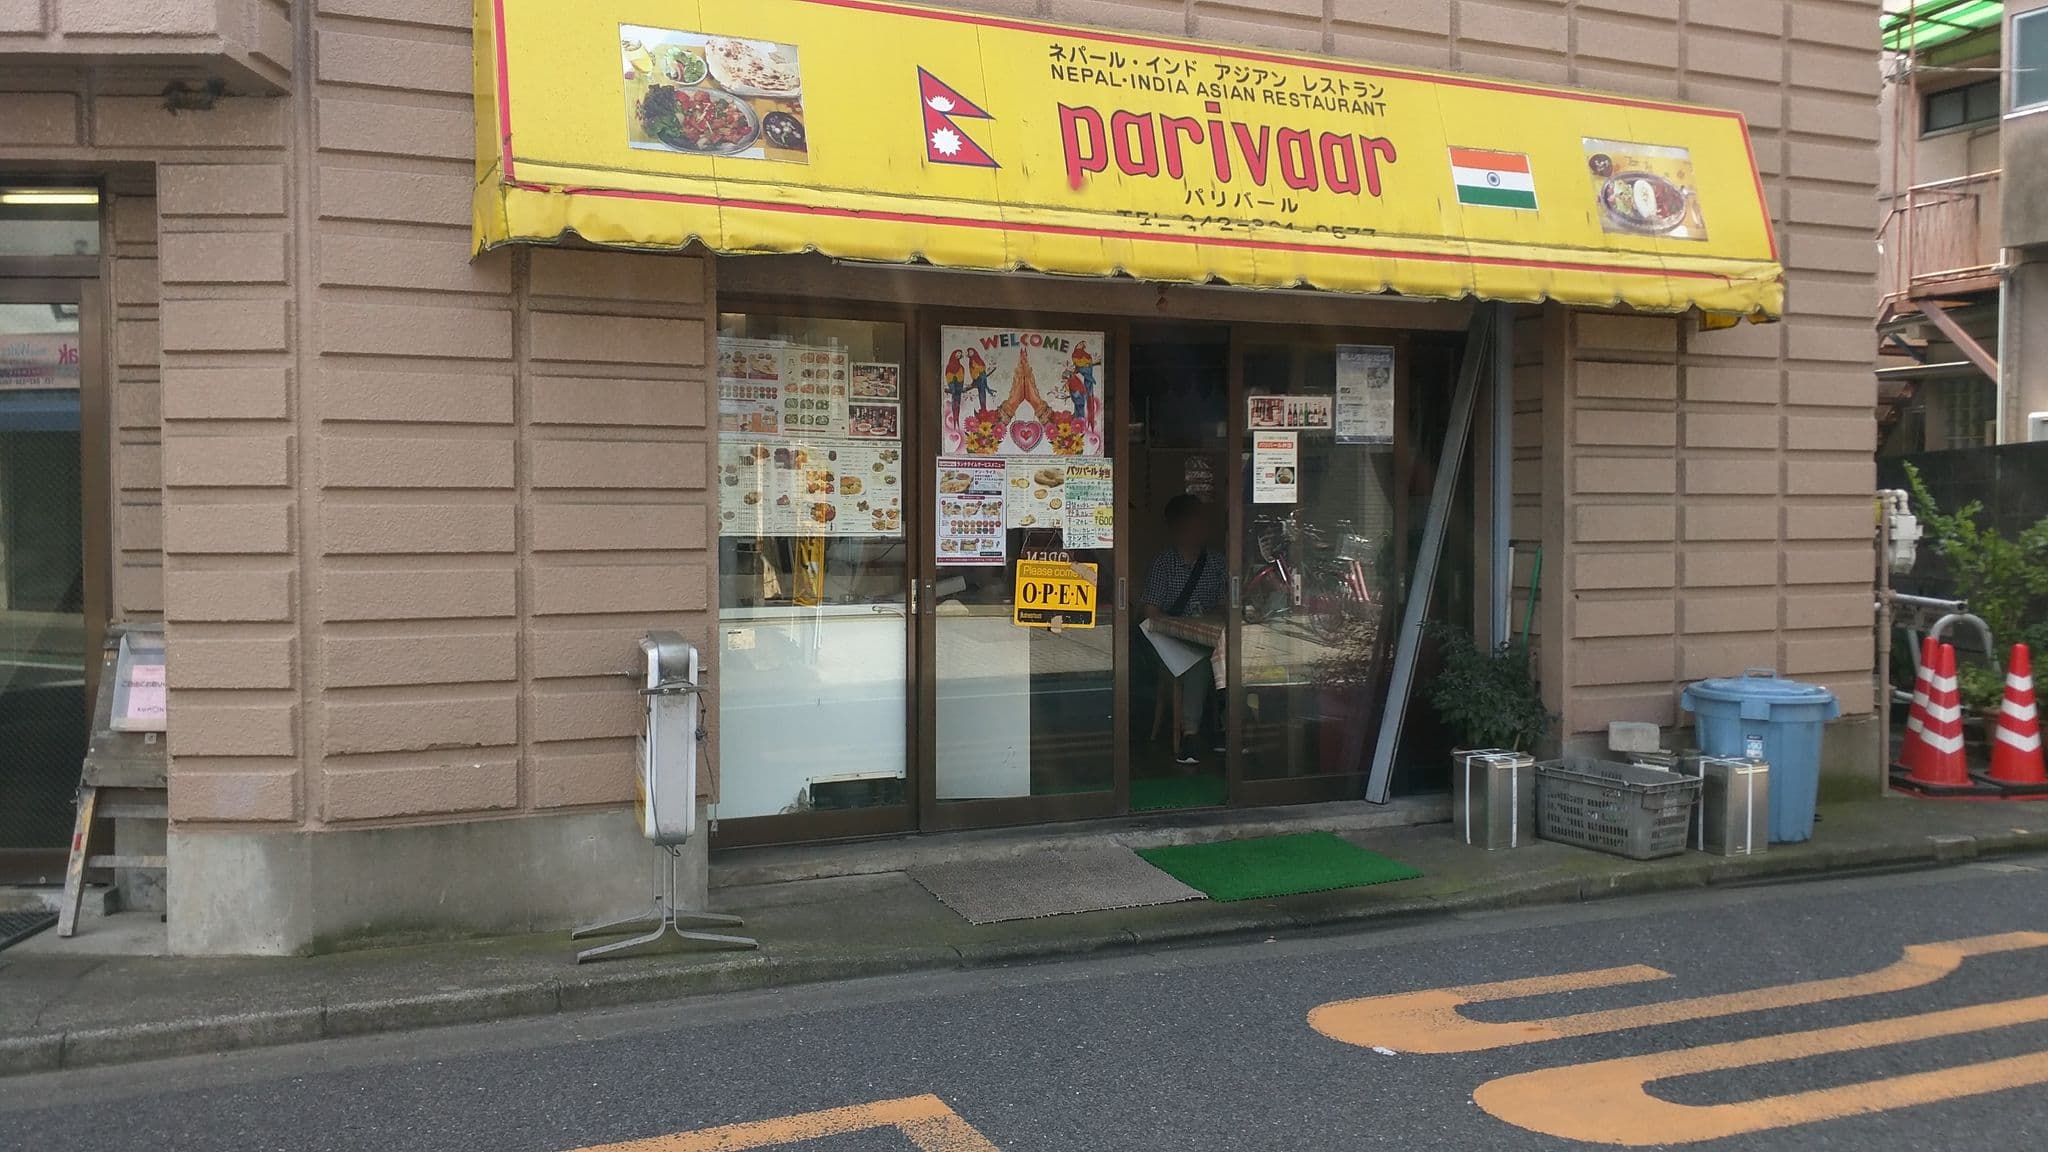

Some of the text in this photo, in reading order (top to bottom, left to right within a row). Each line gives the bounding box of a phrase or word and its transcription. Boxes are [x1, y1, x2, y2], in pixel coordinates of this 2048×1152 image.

[1214, 63, 1287, 88] アジアン
[1303, 75, 1384, 99] レストラン
[1196, 81, 1256, 103] ASIAN
[1263, 89, 1387, 117] RESTAURANT
[1057, 100, 1397, 198] parivaar
[1185, 188, 1299, 214] パリバール
[979, 333, 1070, 354] WELCOME
[1023, 565, 1053, 576] Please
